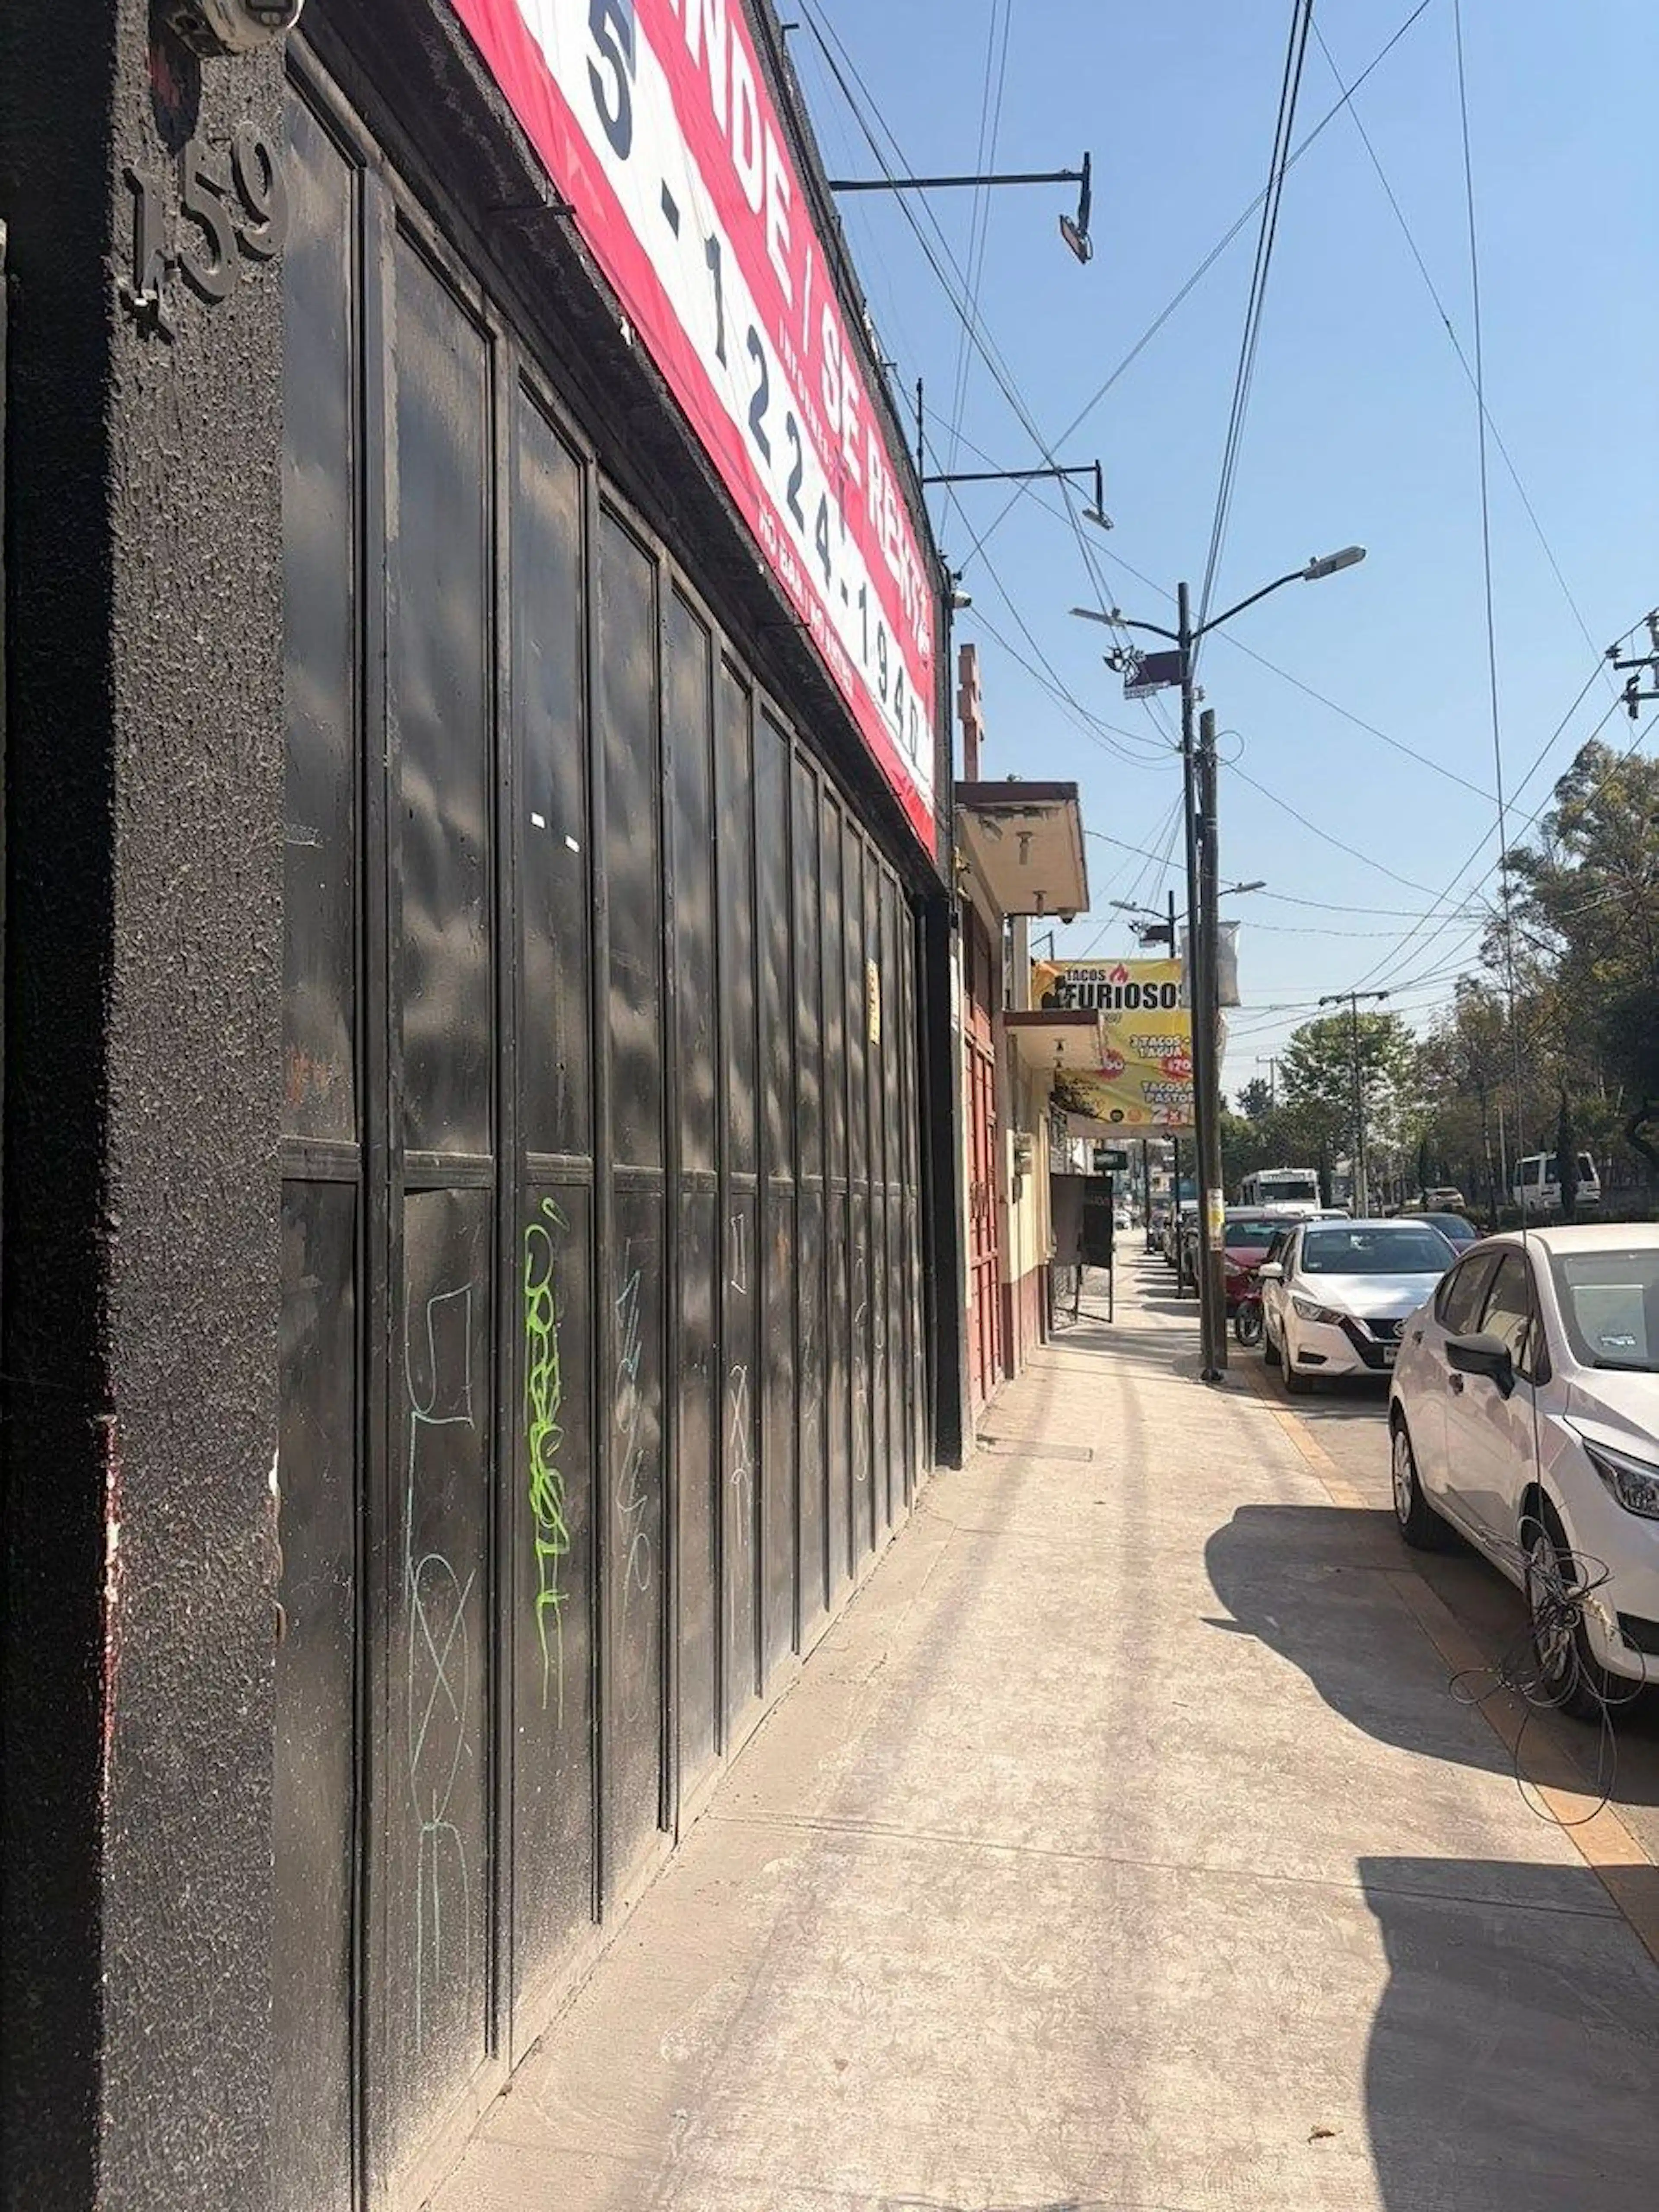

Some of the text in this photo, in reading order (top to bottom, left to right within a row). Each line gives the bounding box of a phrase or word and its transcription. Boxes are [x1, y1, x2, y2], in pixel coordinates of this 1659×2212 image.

[123, 121, 288, 303] 159
[669, 0, 792, 310] NDE
[822, 302, 861, 490] SE
[867, 426, 931, 658] RENTA
[1066, 969, 1106, 981] TACOS
[1065, 983, 1182, 1009] FURIOSO
[1139, 1035, 1181, 1046] TACOS
[1147, 1046, 1183, 1057] AGUA
[1142, 1081, 1183, 1093] TACOS
